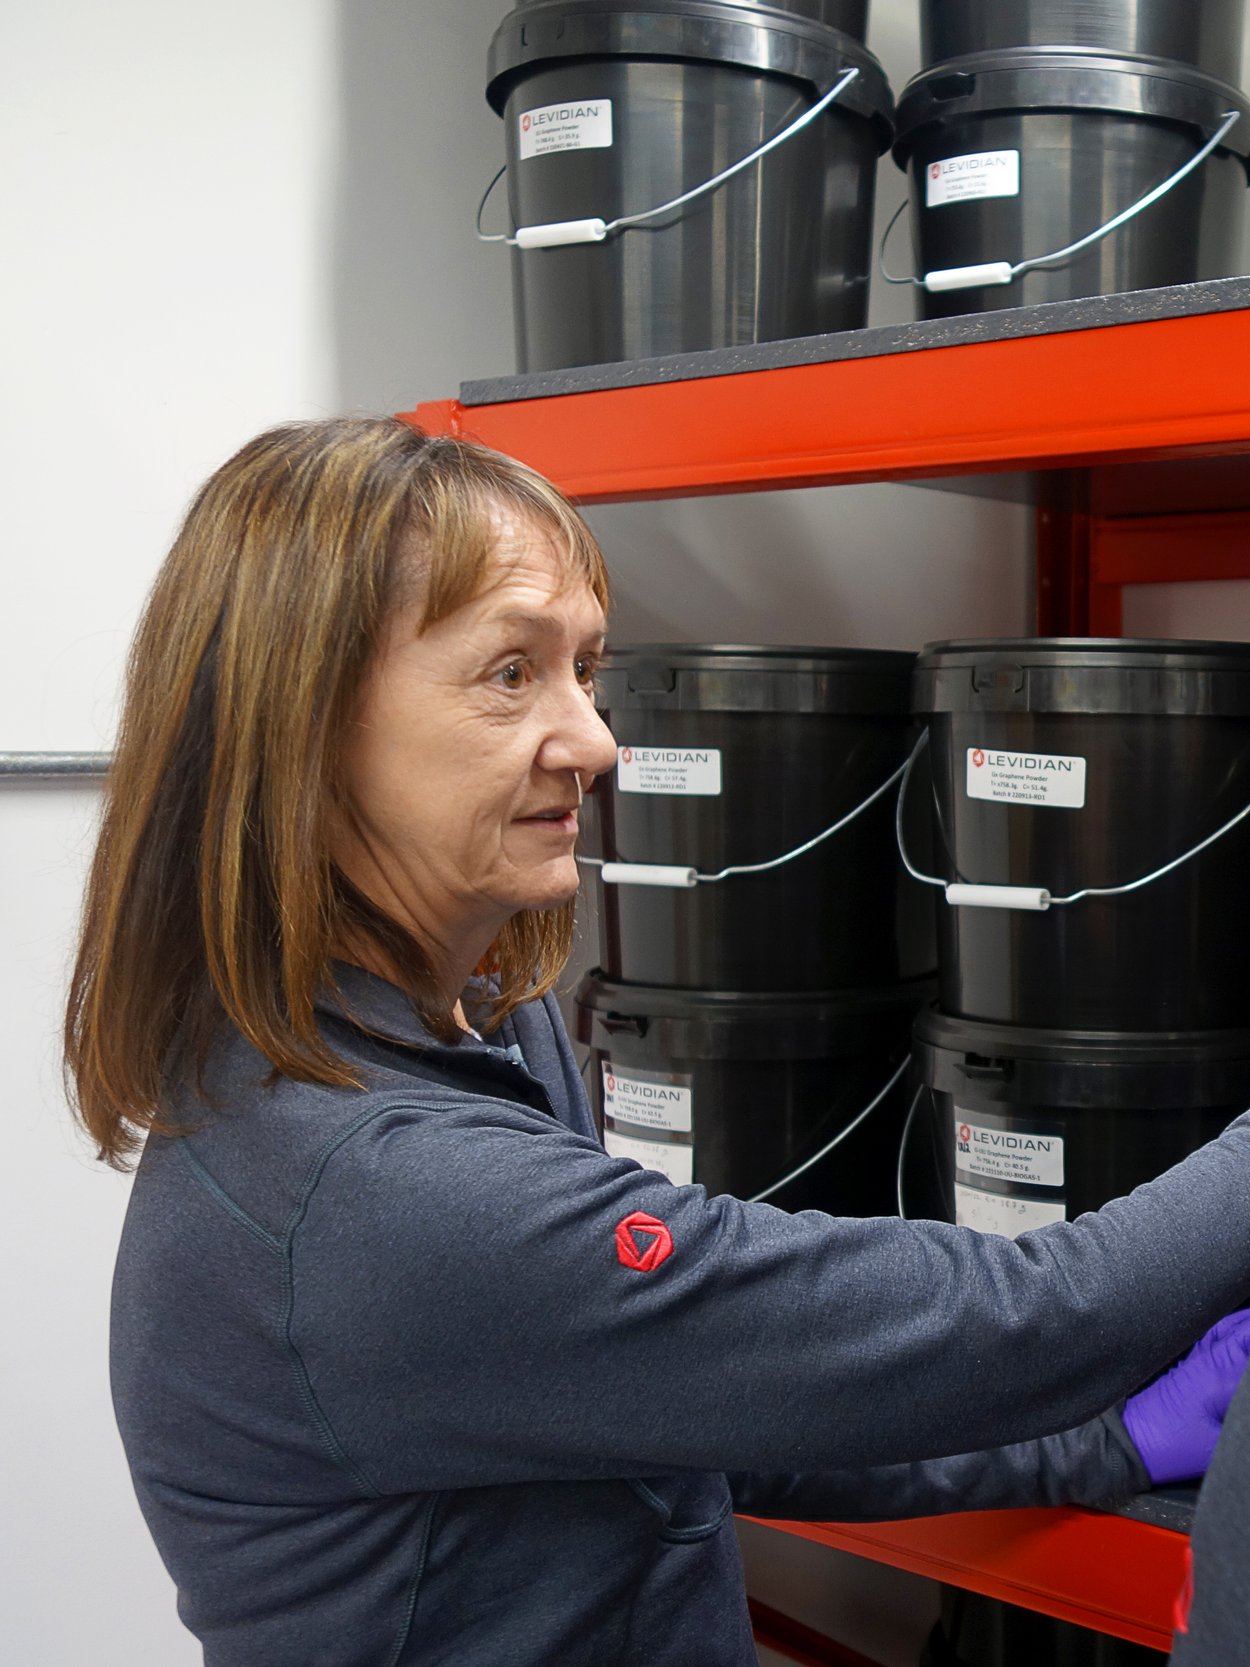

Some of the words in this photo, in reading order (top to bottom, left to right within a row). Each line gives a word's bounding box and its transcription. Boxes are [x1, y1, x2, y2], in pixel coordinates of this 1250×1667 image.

[532, 107, 598, 126] LEVIDIAN
[942, 157, 1006, 174] LEVIDIAN
[635, 752, 708, 763] LEVIDIAN
[988, 754, 1072, 771] LEVIDIAN
[999, 772, 1024, 780] Graphene
[1026, 774, 1048, 782] Powder
[617, 1080, 680, 1102] LEVIDIAN
[973, 1130, 1050, 1152] LEVIDIAN
[987, 1148, 1010, 1158] Graphene
[1012, 1154, 1033, 1162] Powder
